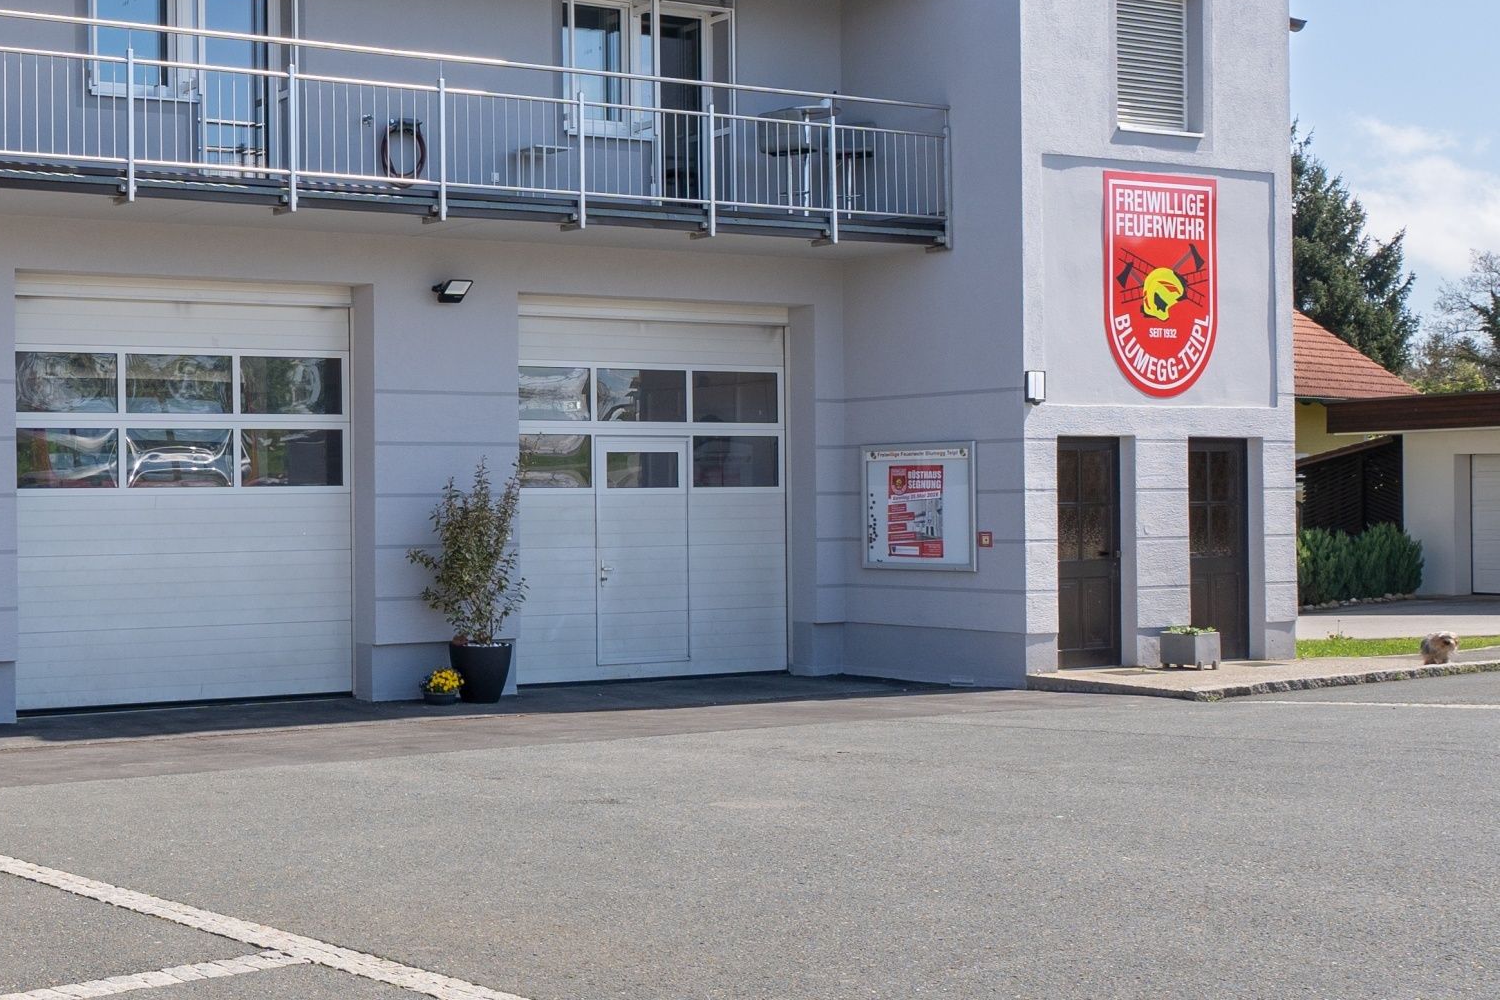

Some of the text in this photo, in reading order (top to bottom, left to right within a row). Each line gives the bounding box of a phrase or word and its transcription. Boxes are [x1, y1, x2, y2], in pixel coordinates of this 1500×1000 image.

[1115, 188, 1205, 216] FREIWILLIGE
[1115, 212, 1205, 241] FEUERWEHR
[1114, 313, 1210, 382] BLUMEGG-TEIPL
[1149, 328, 1177, 339] SEIT 1932
